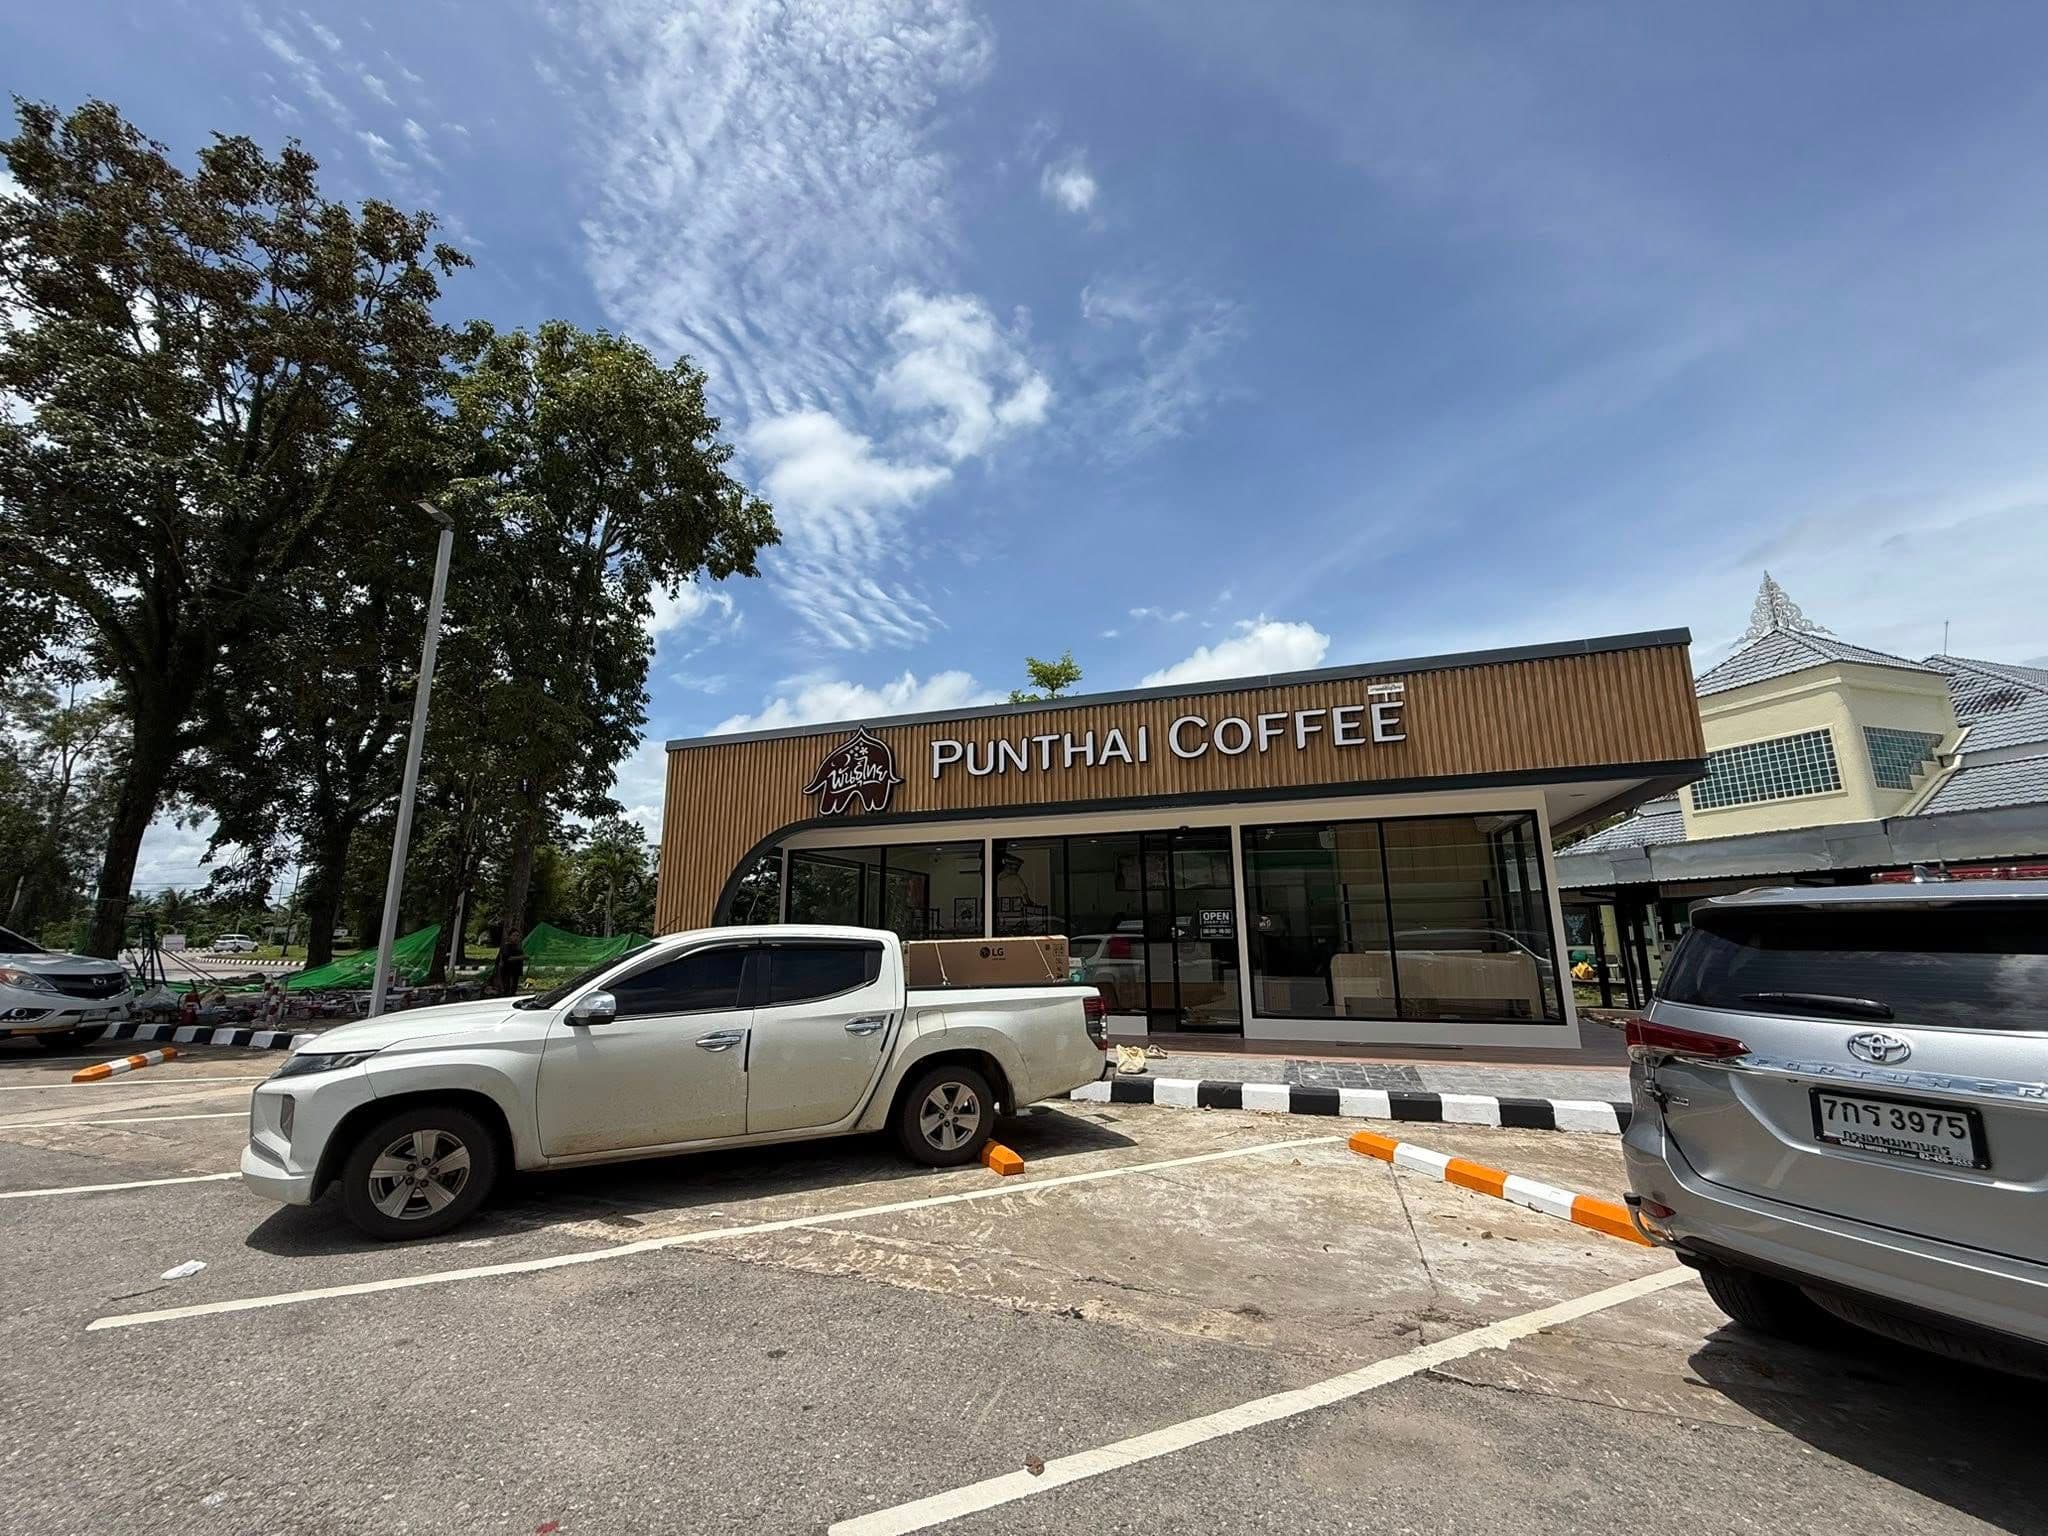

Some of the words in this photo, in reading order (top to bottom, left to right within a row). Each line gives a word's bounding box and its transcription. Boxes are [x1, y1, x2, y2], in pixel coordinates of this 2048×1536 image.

[931, 726, 1148, 779] PUNTHAI
[1167, 700, 1408, 760] COFFEE
[1203, 912, 1229, 920] OPEN
[1822, 1099, 1881, 1127] 7กร
[1890, 1108, 1967, 1140] 3975
[1843, 1130, 1951, 1156] กรงเทพมหานคร
